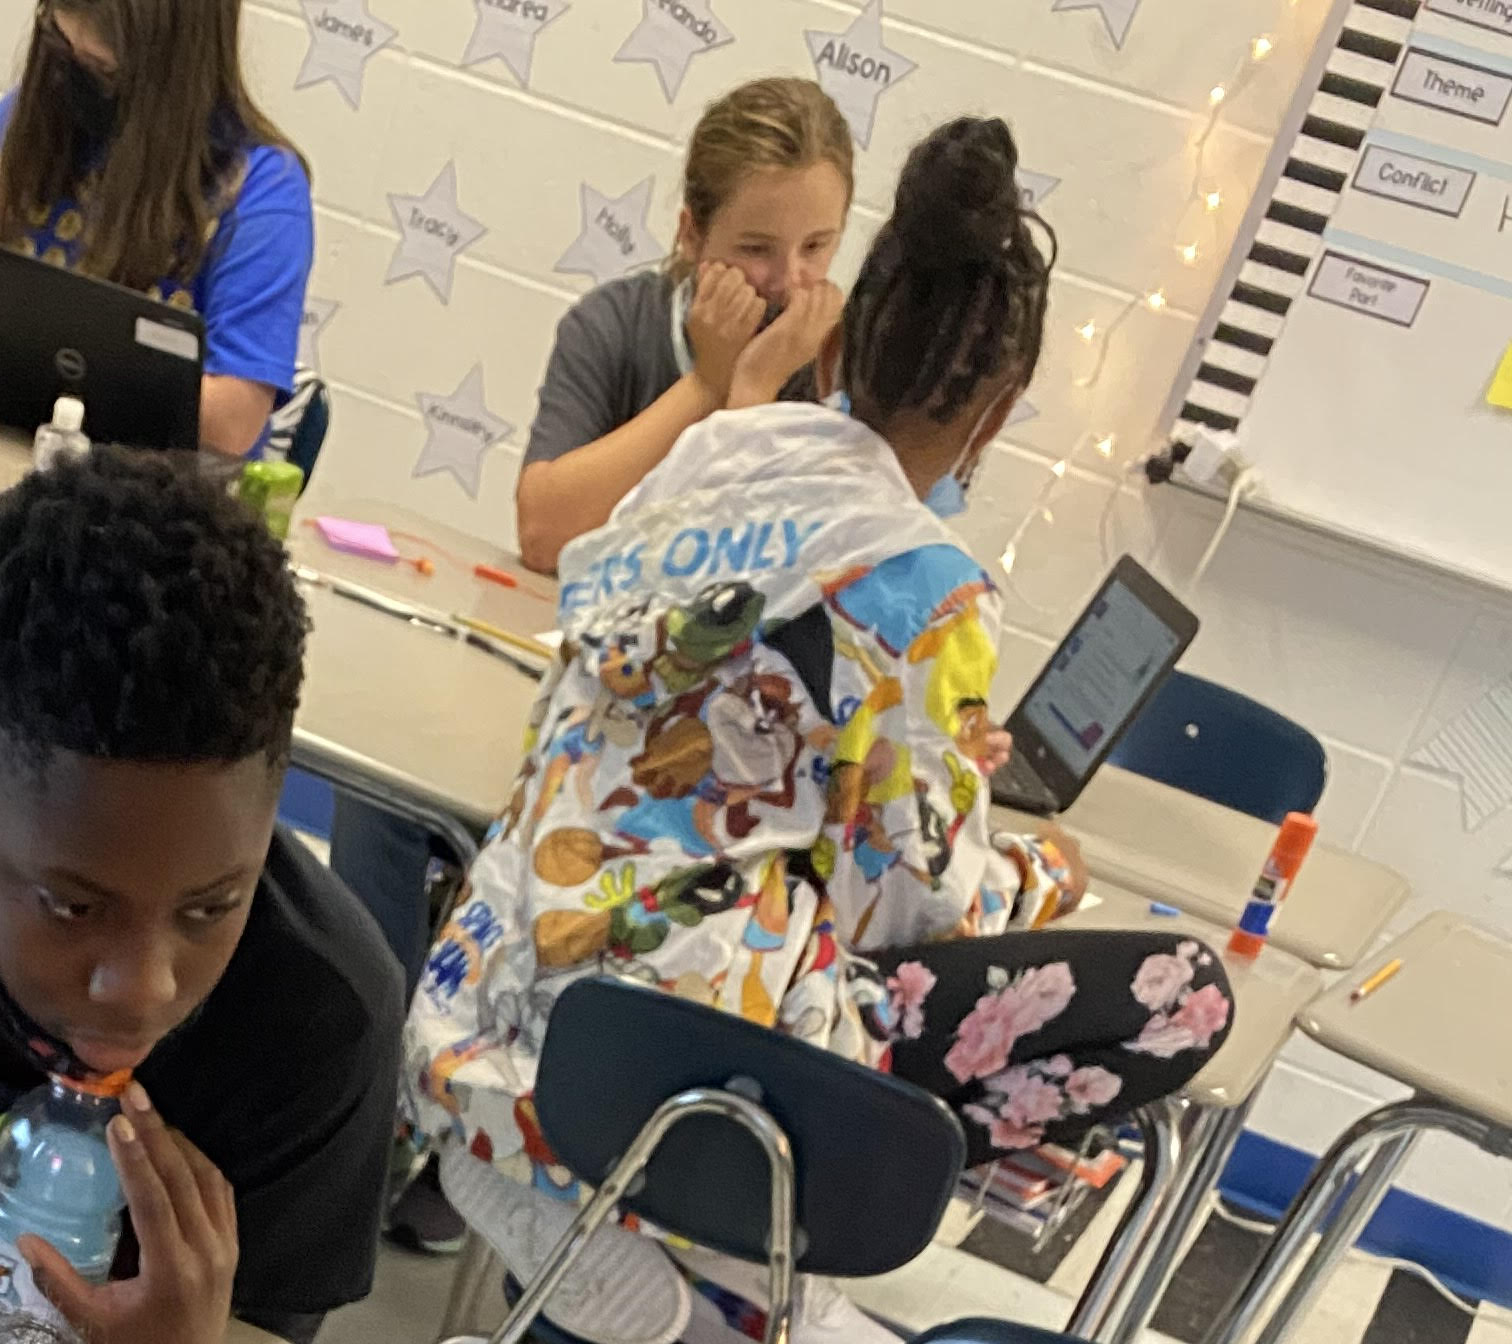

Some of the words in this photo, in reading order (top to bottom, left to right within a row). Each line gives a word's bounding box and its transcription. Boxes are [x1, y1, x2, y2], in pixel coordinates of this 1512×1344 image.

[315, 8, 373, 46] James
[818, 41, 890, 83] Alison
[1423, 69, 1485, 102] Theme
[1378, 162, 1448, 197] Conflict
[409, 206, 458, 246] Tracy
[595, 207, 635, 256] Holly
[662, 517, 823, 577] ONLY
